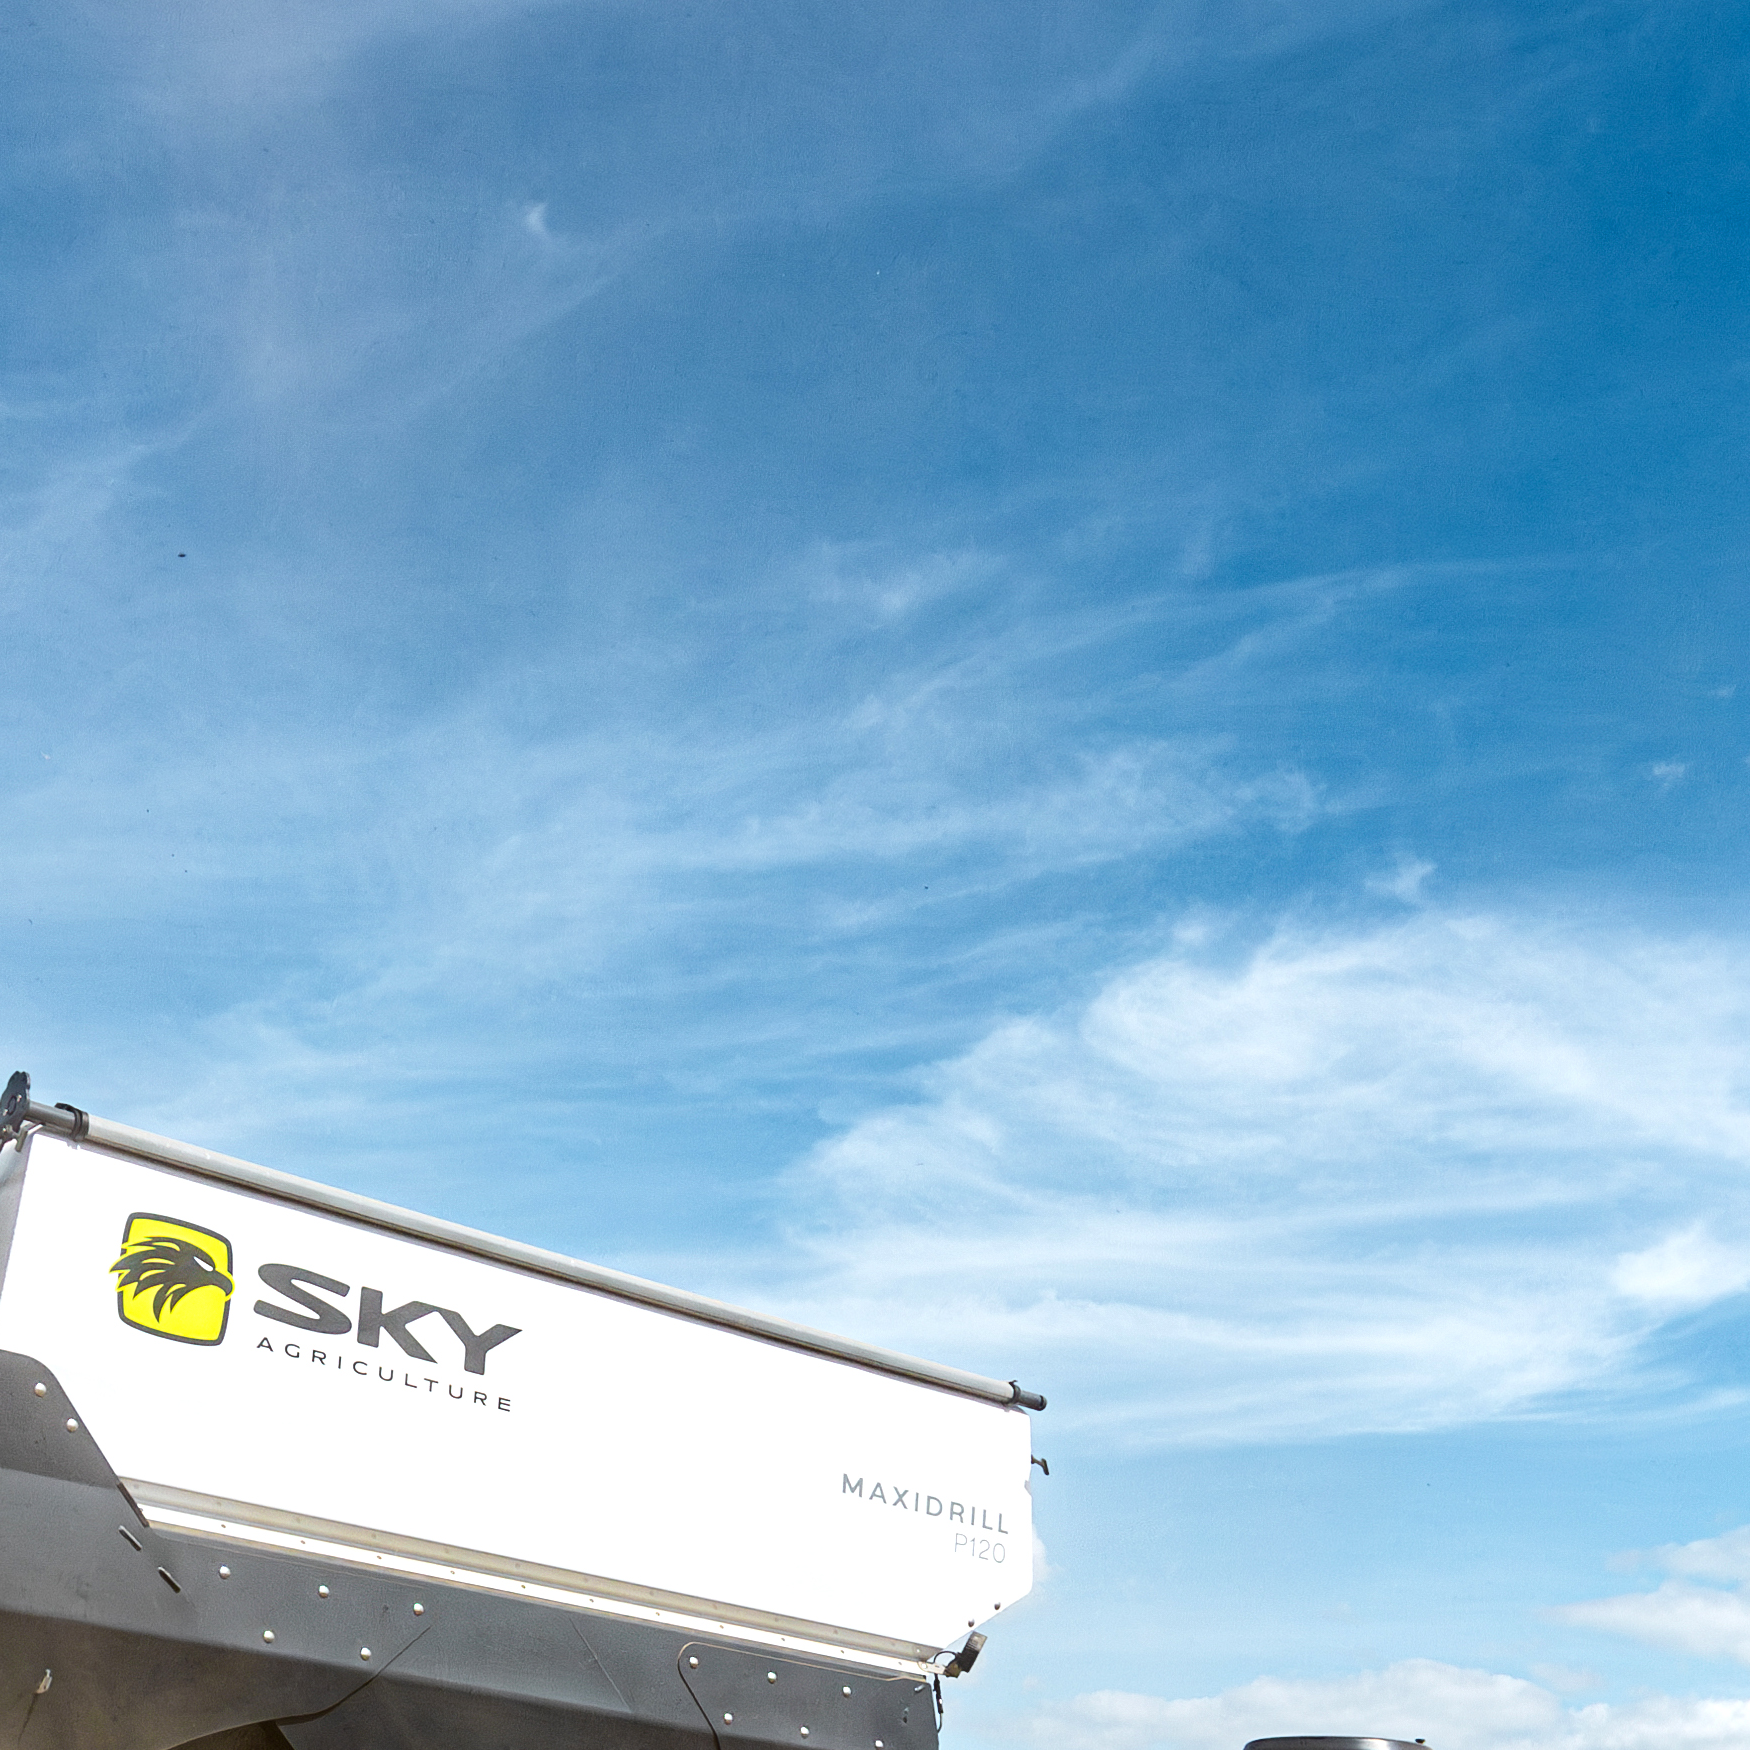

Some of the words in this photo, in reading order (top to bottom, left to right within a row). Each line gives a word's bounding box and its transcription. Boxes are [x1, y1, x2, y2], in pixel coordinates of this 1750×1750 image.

[253, 1263, 523, 1376] SKY
[256, 1336, 511, 1413] AGRICULTURE
[842, 1473, 1008, 1534] MAXIDRILL
[955, 1532, 1006, 1564] P120
